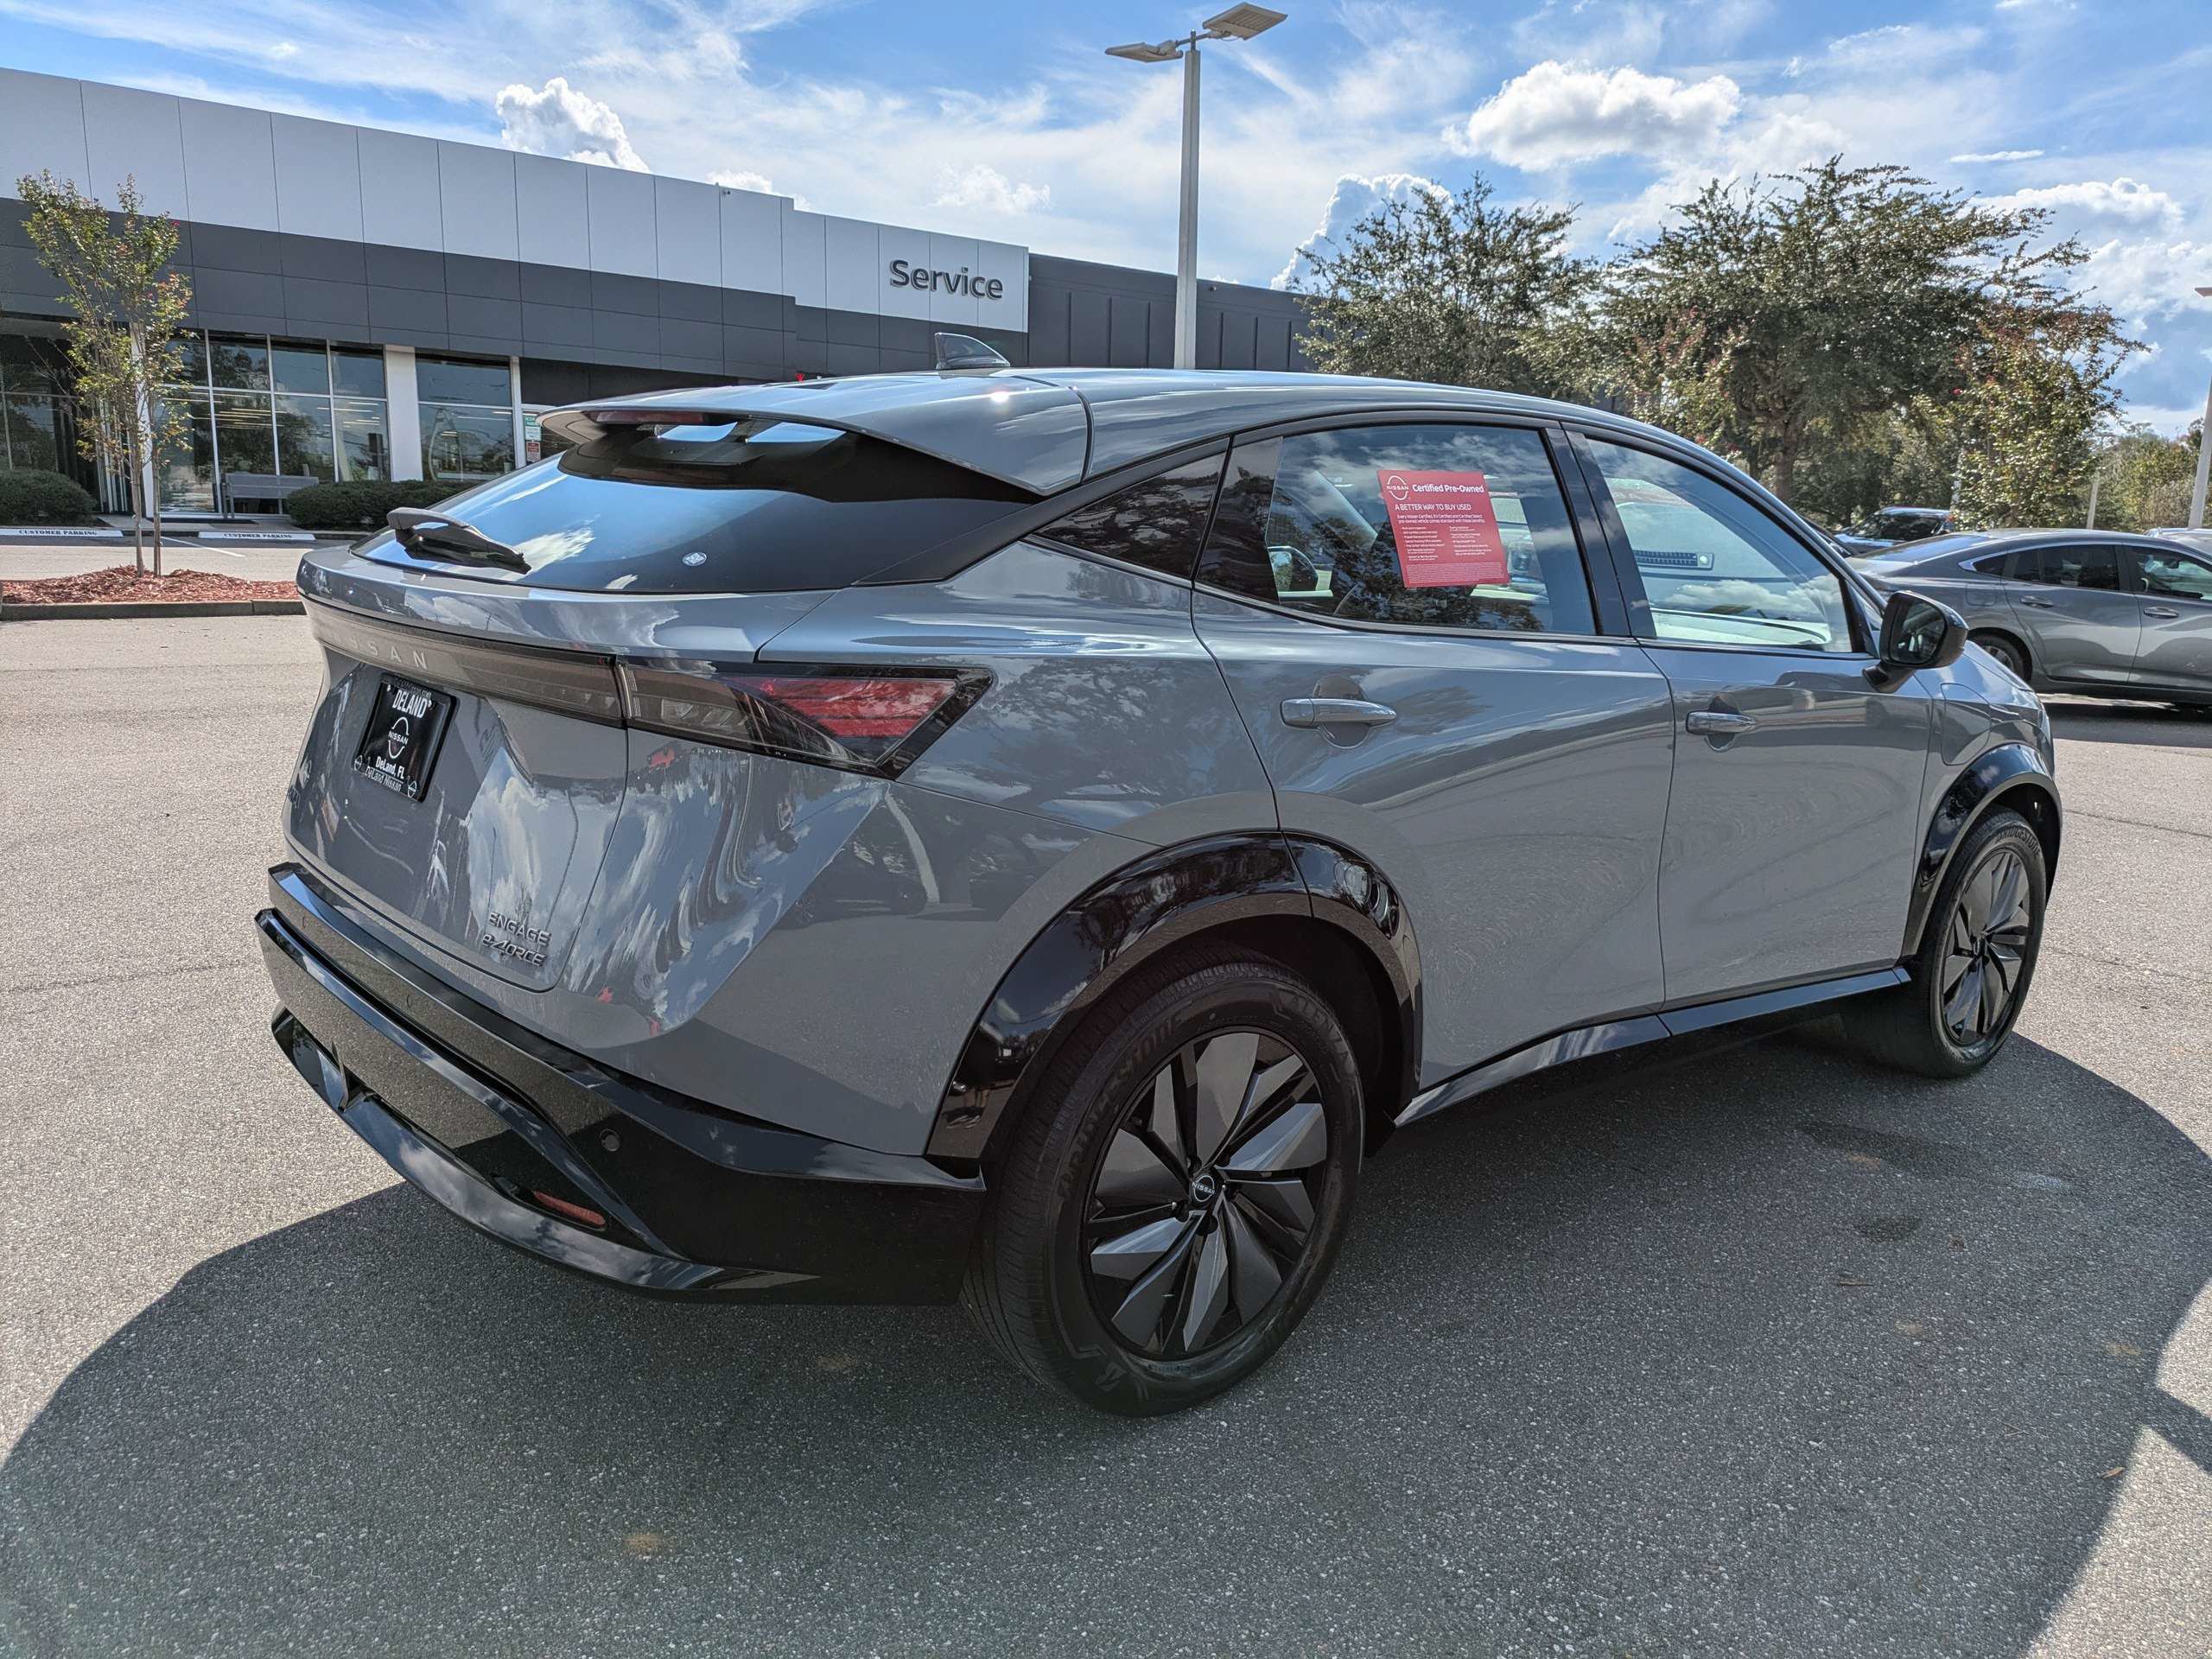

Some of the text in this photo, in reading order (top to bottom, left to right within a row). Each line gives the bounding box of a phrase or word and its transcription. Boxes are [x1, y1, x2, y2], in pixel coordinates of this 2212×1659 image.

[890, 259, 1003, 301] Service
[1444, 485, 1484, 493] Pre-Owned
[392, 690, 428, 719] DELAND
[388, 731, 409, 745] NISSAN
[376, 756, 397, 777] DeLand,
[397, 766, 405, 779] FL
[489, 912, 552, 947] ENGAGE
[1192, 1181, 1216, 1195] NISSAN
